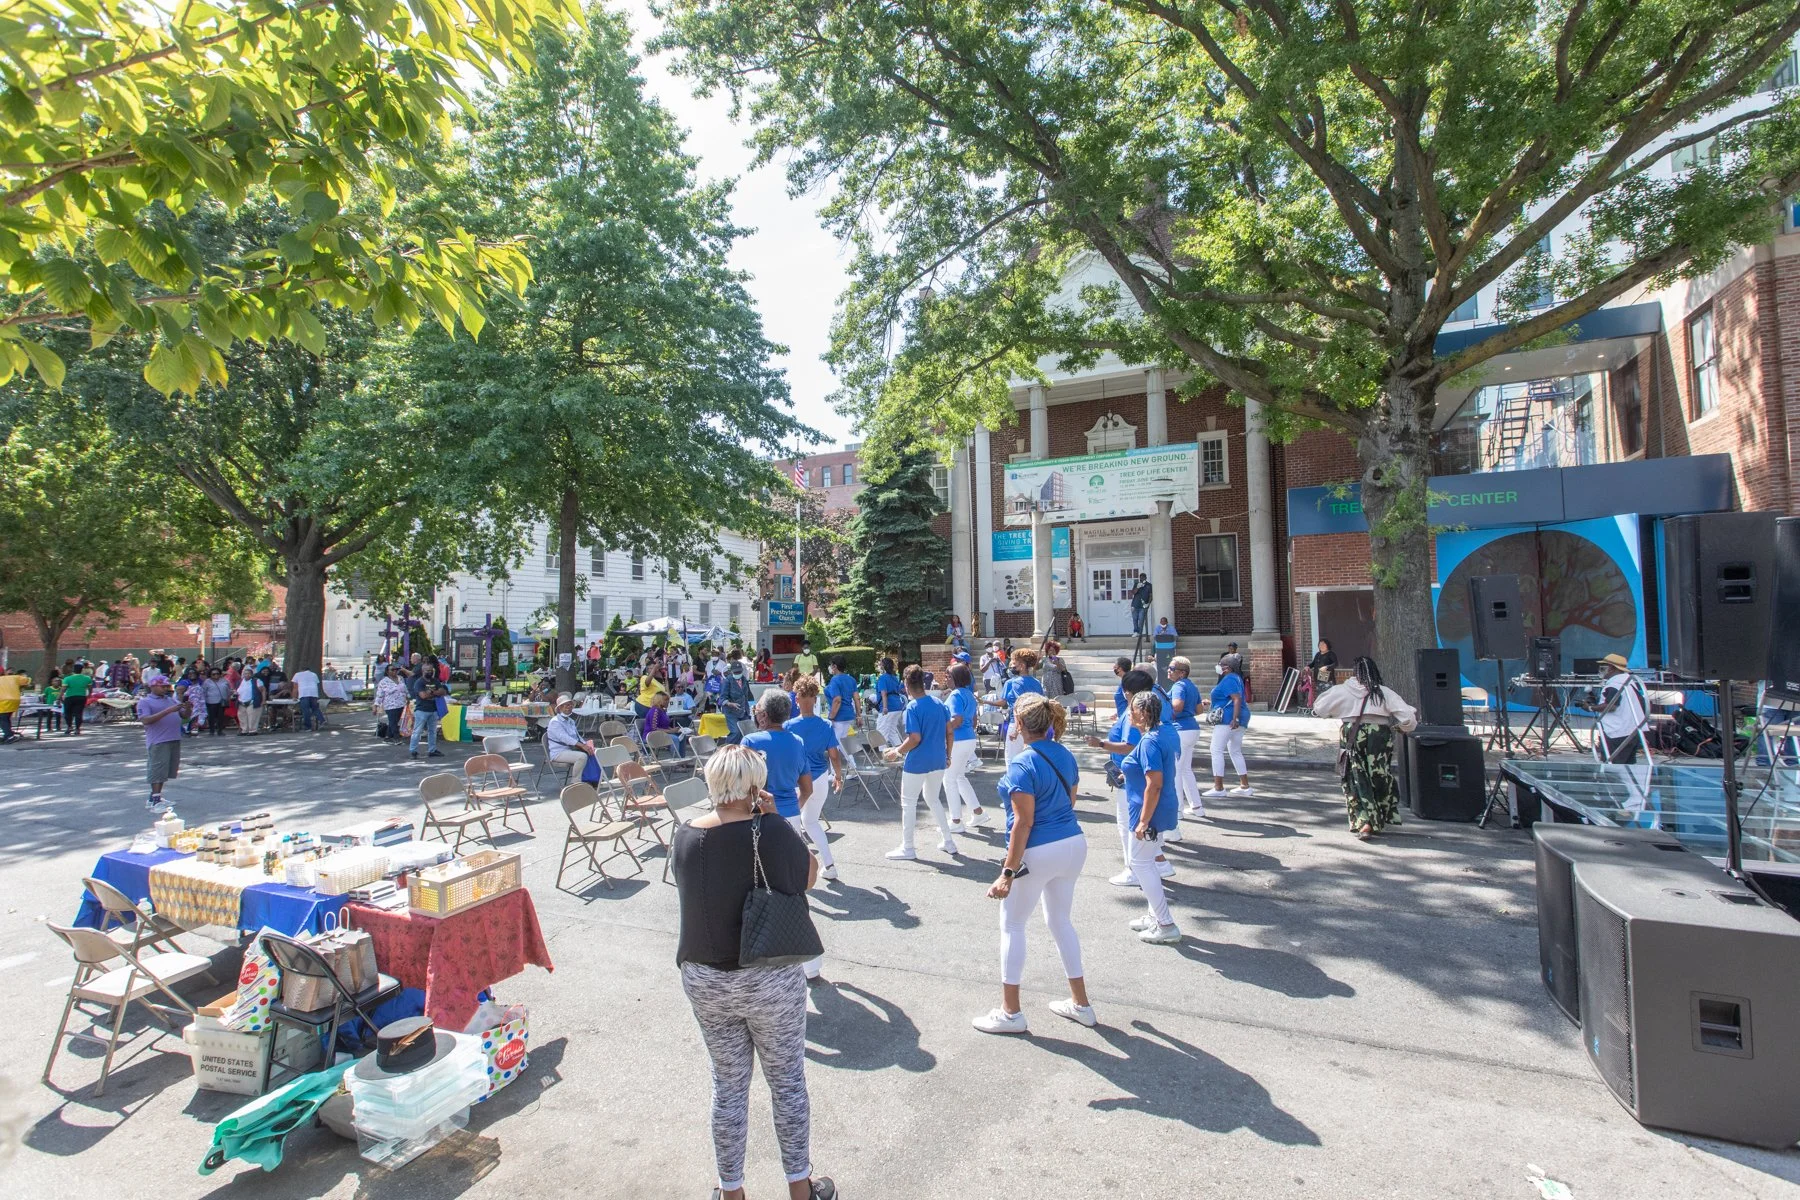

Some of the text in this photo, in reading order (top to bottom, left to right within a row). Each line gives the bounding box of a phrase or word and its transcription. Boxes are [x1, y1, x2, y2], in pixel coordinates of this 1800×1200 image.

[1062, 453, 1194, 473] WE'RE BREAKING NEW GROUND...
[1161, 466, 1188, 474] CENTER
[1447, 491, 1518, 507] CENTER
[998, 538, 1021, 546] GIVING
[770, 608, 802, 616] Presbyterian
[201, 1055, 254, 1068] UNITED STATES
[200, 1064, 257, 1078] POSTAL SERVICE
